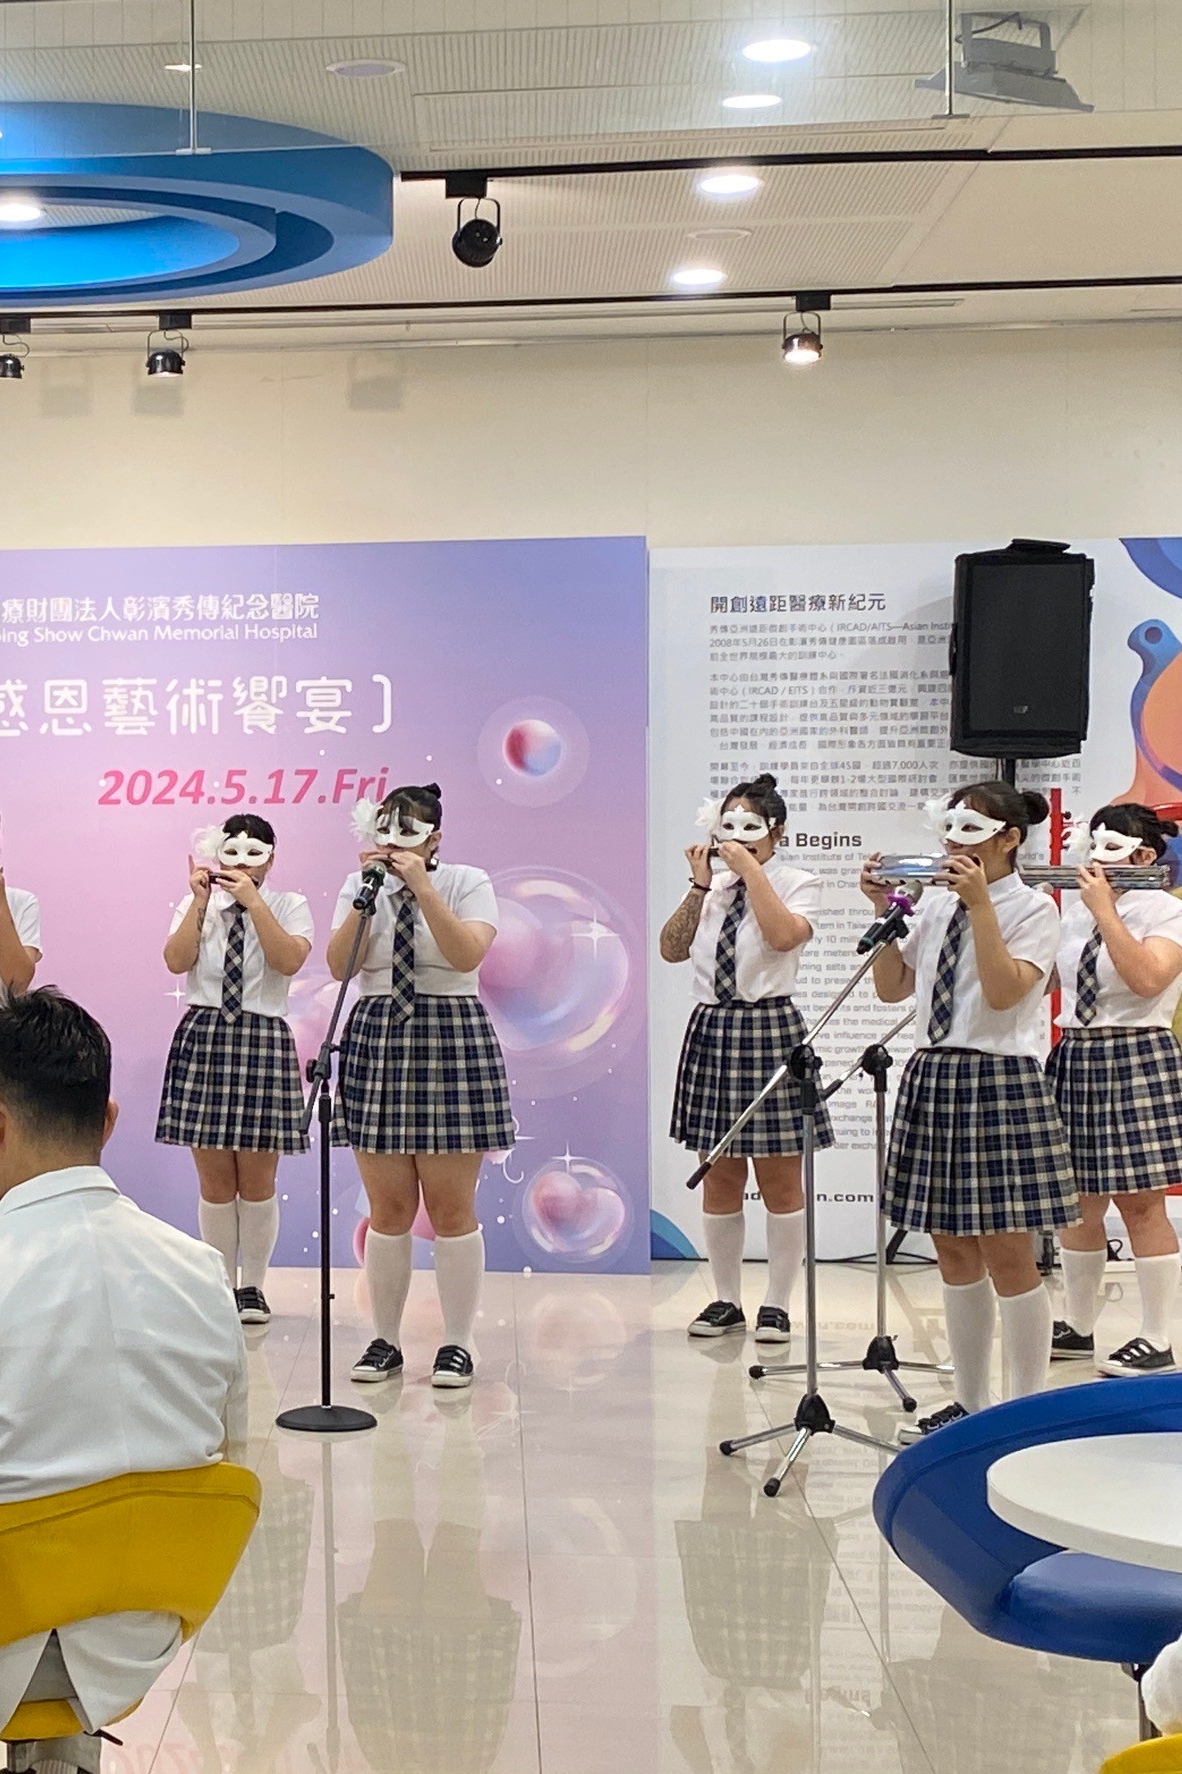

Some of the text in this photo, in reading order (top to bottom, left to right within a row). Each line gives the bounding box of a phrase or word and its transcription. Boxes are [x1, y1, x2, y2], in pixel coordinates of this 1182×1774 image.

[710, 592, 887, 614] 開創遠距醫療新紀元
[33, 625, 84, 643] Show
[87, 624, 150, 643] Chwan
[153, 623, 240, 641] Memorial
[243, 621, 319, 643] Hospital
[97, 766, 391, 806] 2024.5.17.Fri
[795, 831, 863, 850] Begins
